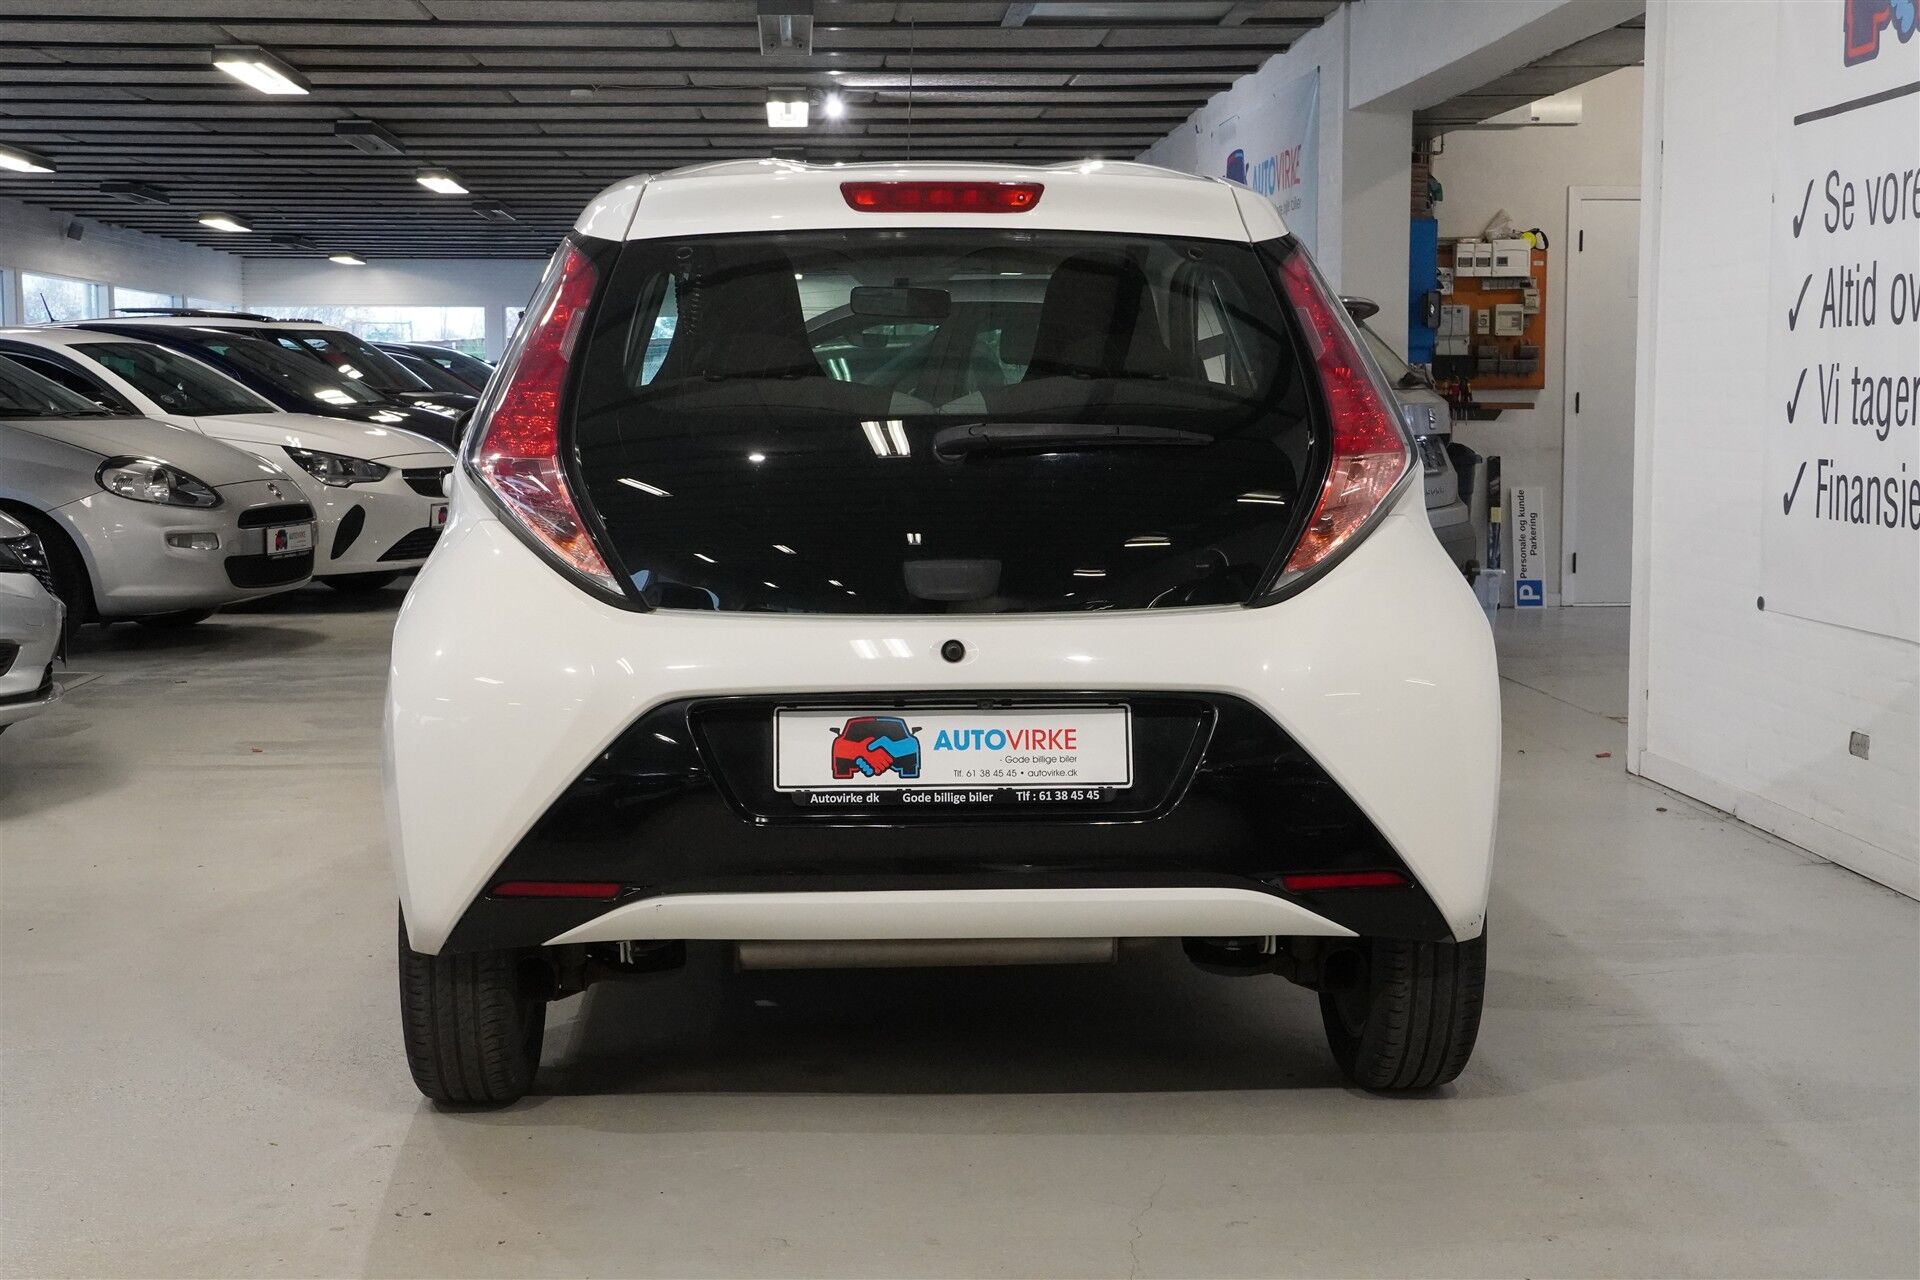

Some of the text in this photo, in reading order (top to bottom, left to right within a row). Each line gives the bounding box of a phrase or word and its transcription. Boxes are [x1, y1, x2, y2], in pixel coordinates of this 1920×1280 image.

[1825, 167, 1920, 234] Se vore
[1819, 260, 1877, 329] Altid
[1818, 362, 1840, 425] Vi
[1517, 489, 1526, 518] kunde
[1815, 458, 1920, 531] Finansie
[1520, 520, 1528, 532] og
[1529, 511, 1538, 556] Parkering
[933, 728, 1078, 751] AUTOVIRKE
[954, 769, 1079, 778] Tlf. 61 38 45 45 autovirke.dk
[1005, 755, 1078, 765] Gode billige biler
[810, 793, 863, 804] Autovirke
[866, 793, 880, 803] dk
[902, 793, 932, 803] Gode
[934, 792, 967, 804] billige
[969, 792, 994, 802] biler
[1016, 791, 1031, 801] Tlf
[1039, 791, 1053, 801] 61
[1055, 790, 1069, 801] 38
[1070, 790, 1084, 800] 45
[1086, 790, 1100, 800] 45
